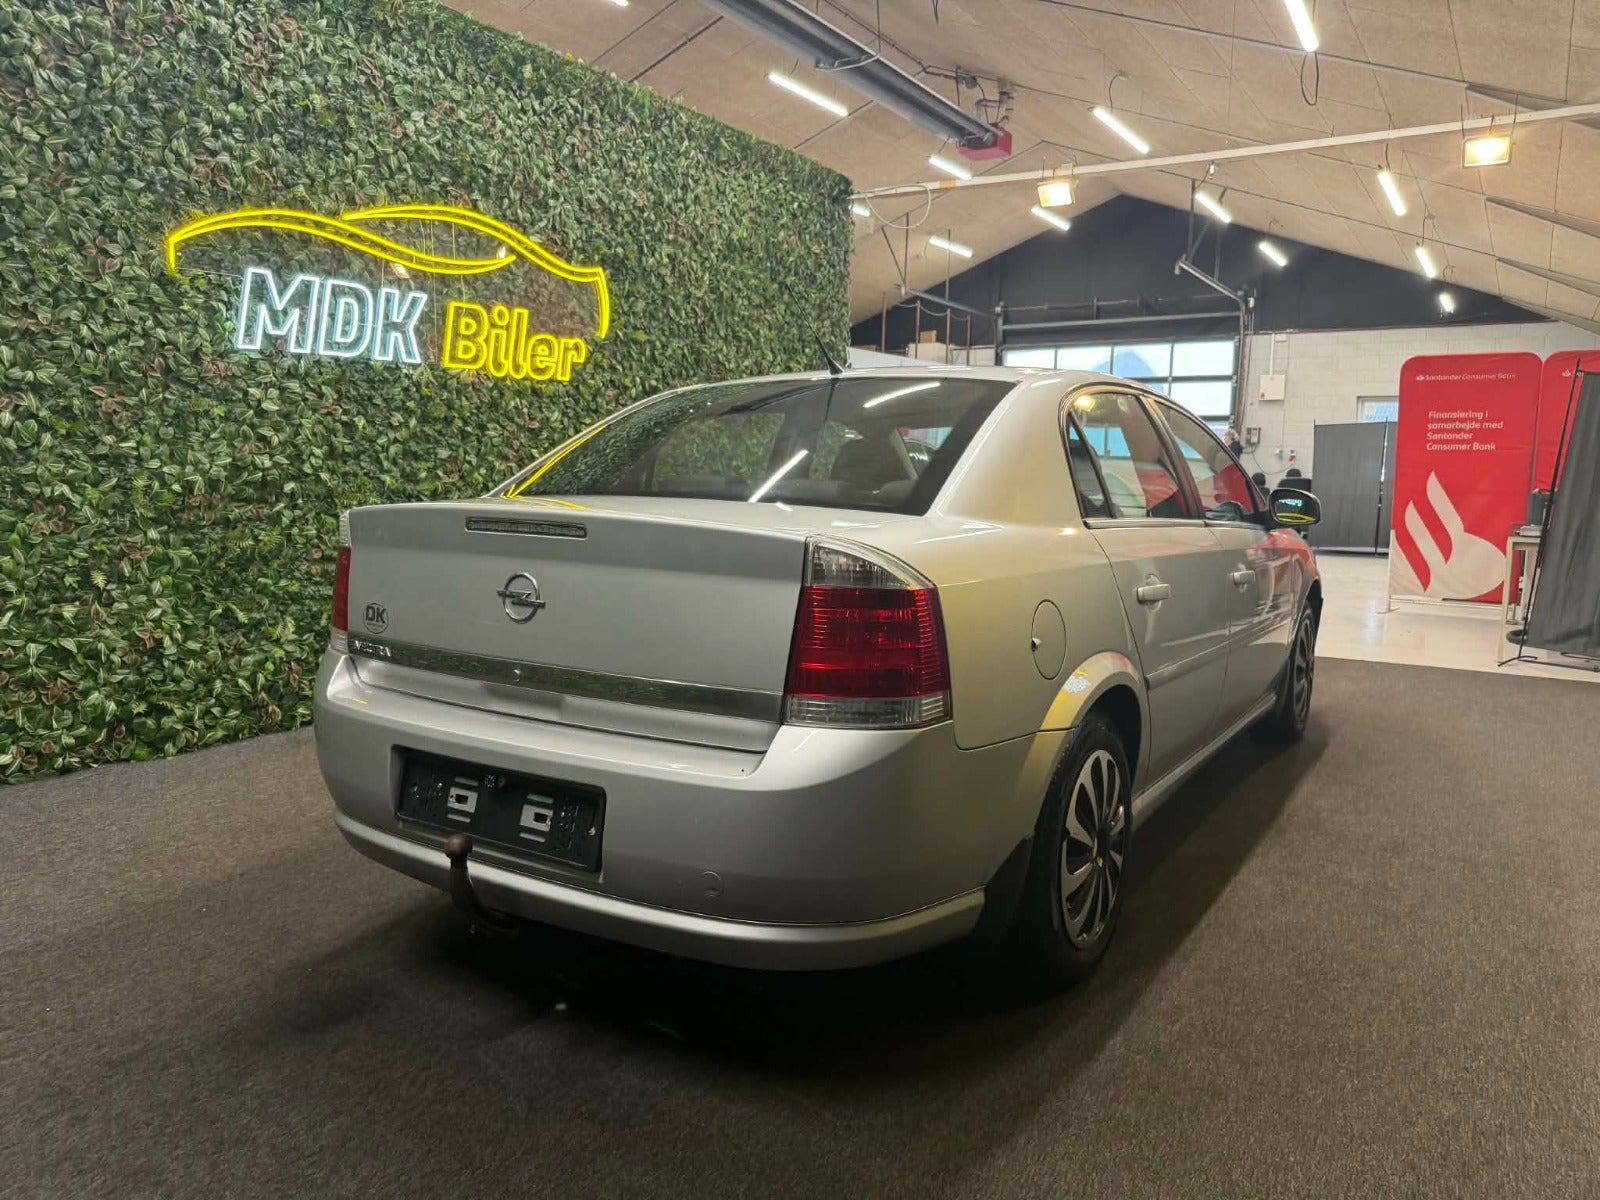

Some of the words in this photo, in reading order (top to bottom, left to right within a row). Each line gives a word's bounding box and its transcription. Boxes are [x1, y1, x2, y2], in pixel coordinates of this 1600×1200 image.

[236, 265, 428, 365] MDK
[442, 299, 587, 383] Biler
[1428, 410, 1483, 420] Finansiering
[1427, 420, 1481, 431] samarbejde
[1482, 420, 1504, 430] med
[1426, 432, 1473, 440] Santander
[1426, 442, 1471, 451] Consumer
[1472, 441, 1496, 451] Bank
[366, 605, 386, 624] DK
